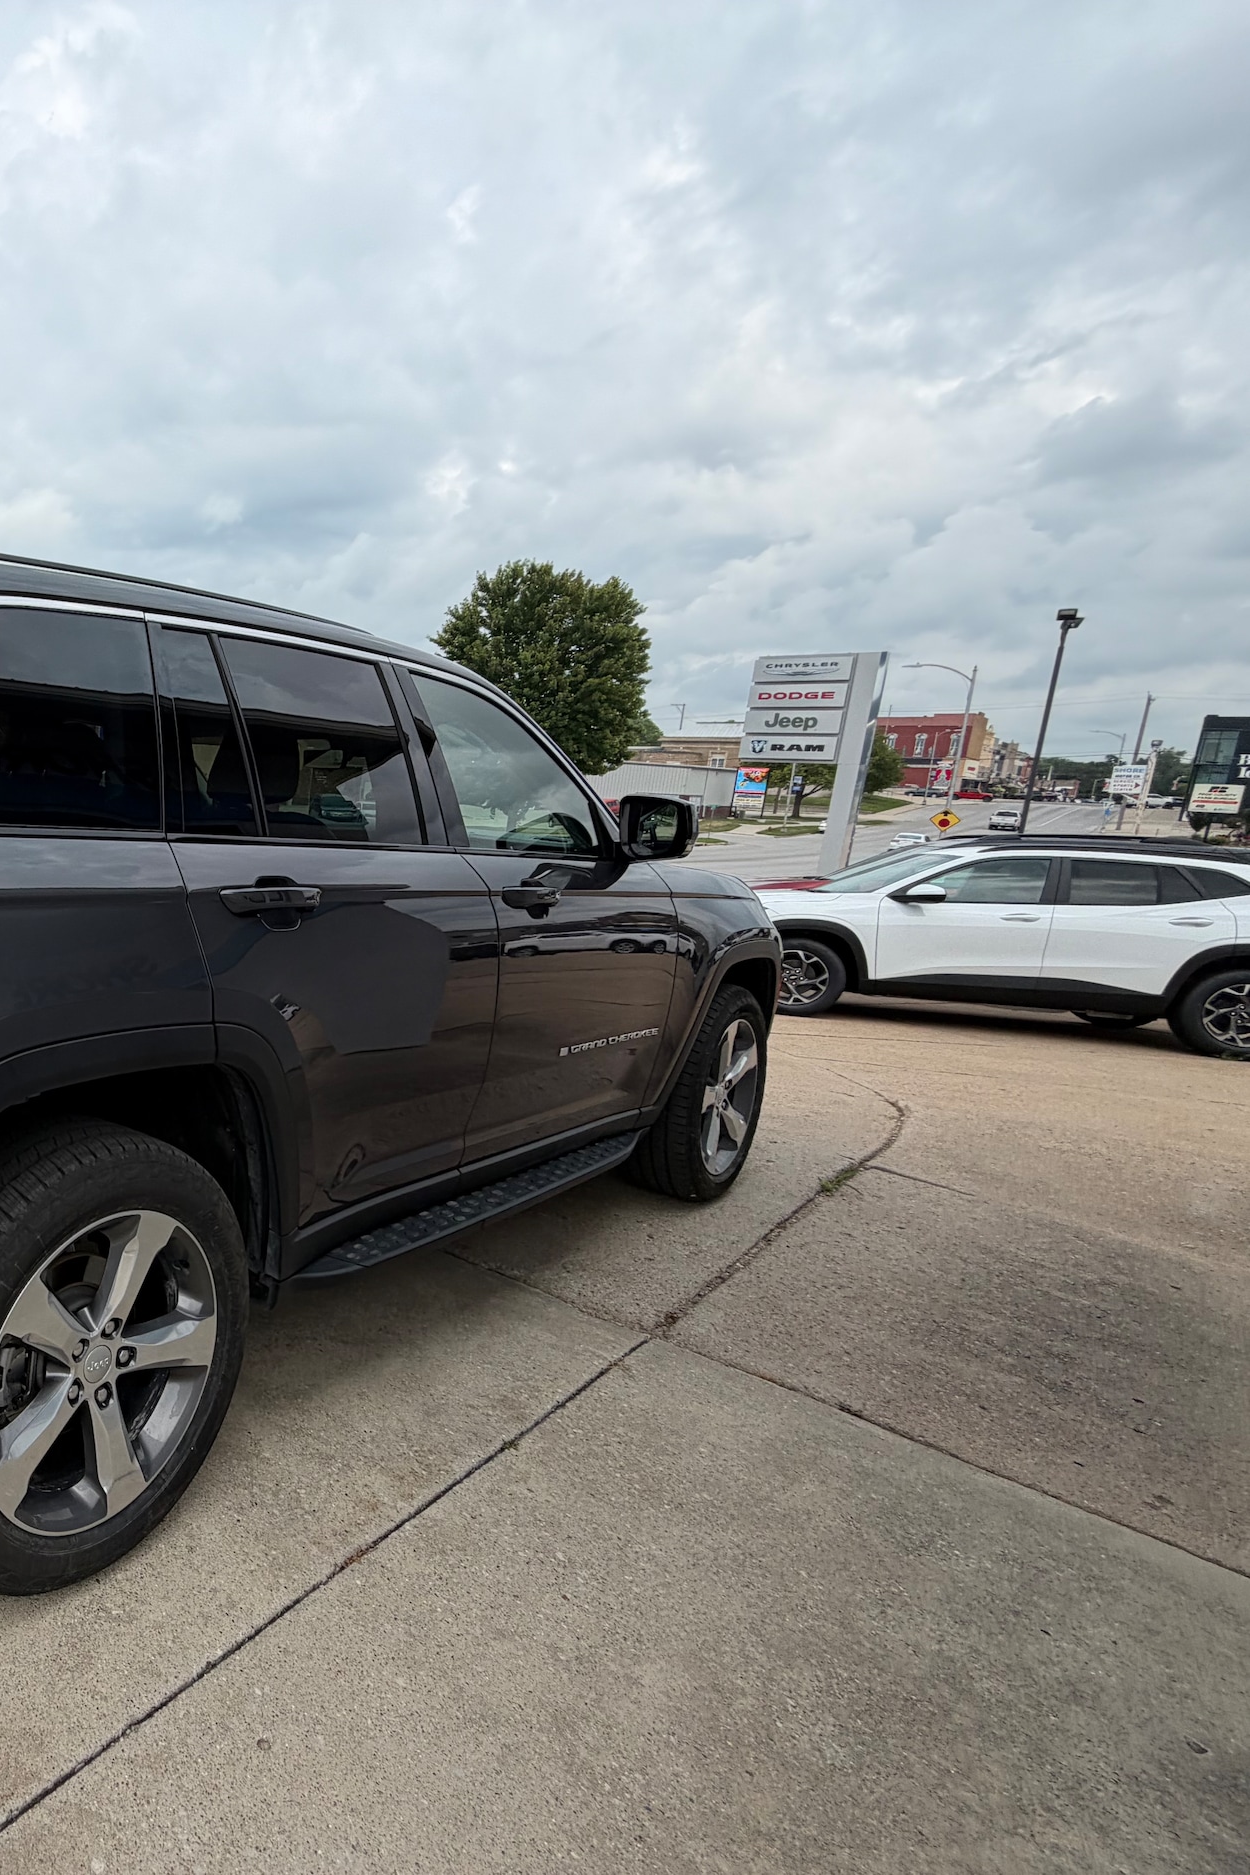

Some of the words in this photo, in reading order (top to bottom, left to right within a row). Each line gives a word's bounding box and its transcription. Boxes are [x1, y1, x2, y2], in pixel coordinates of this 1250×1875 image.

[765, 661, 839, 669] CHRYSLER
[757, 691, 836, 700] DODGE
[764, 712, 818, 731] Jeep
[769, 744, 825, 752] RAM
[570, 1039, 607, 1053] GRAND
[608, 1028, 659, 1045] CHEROKEE
